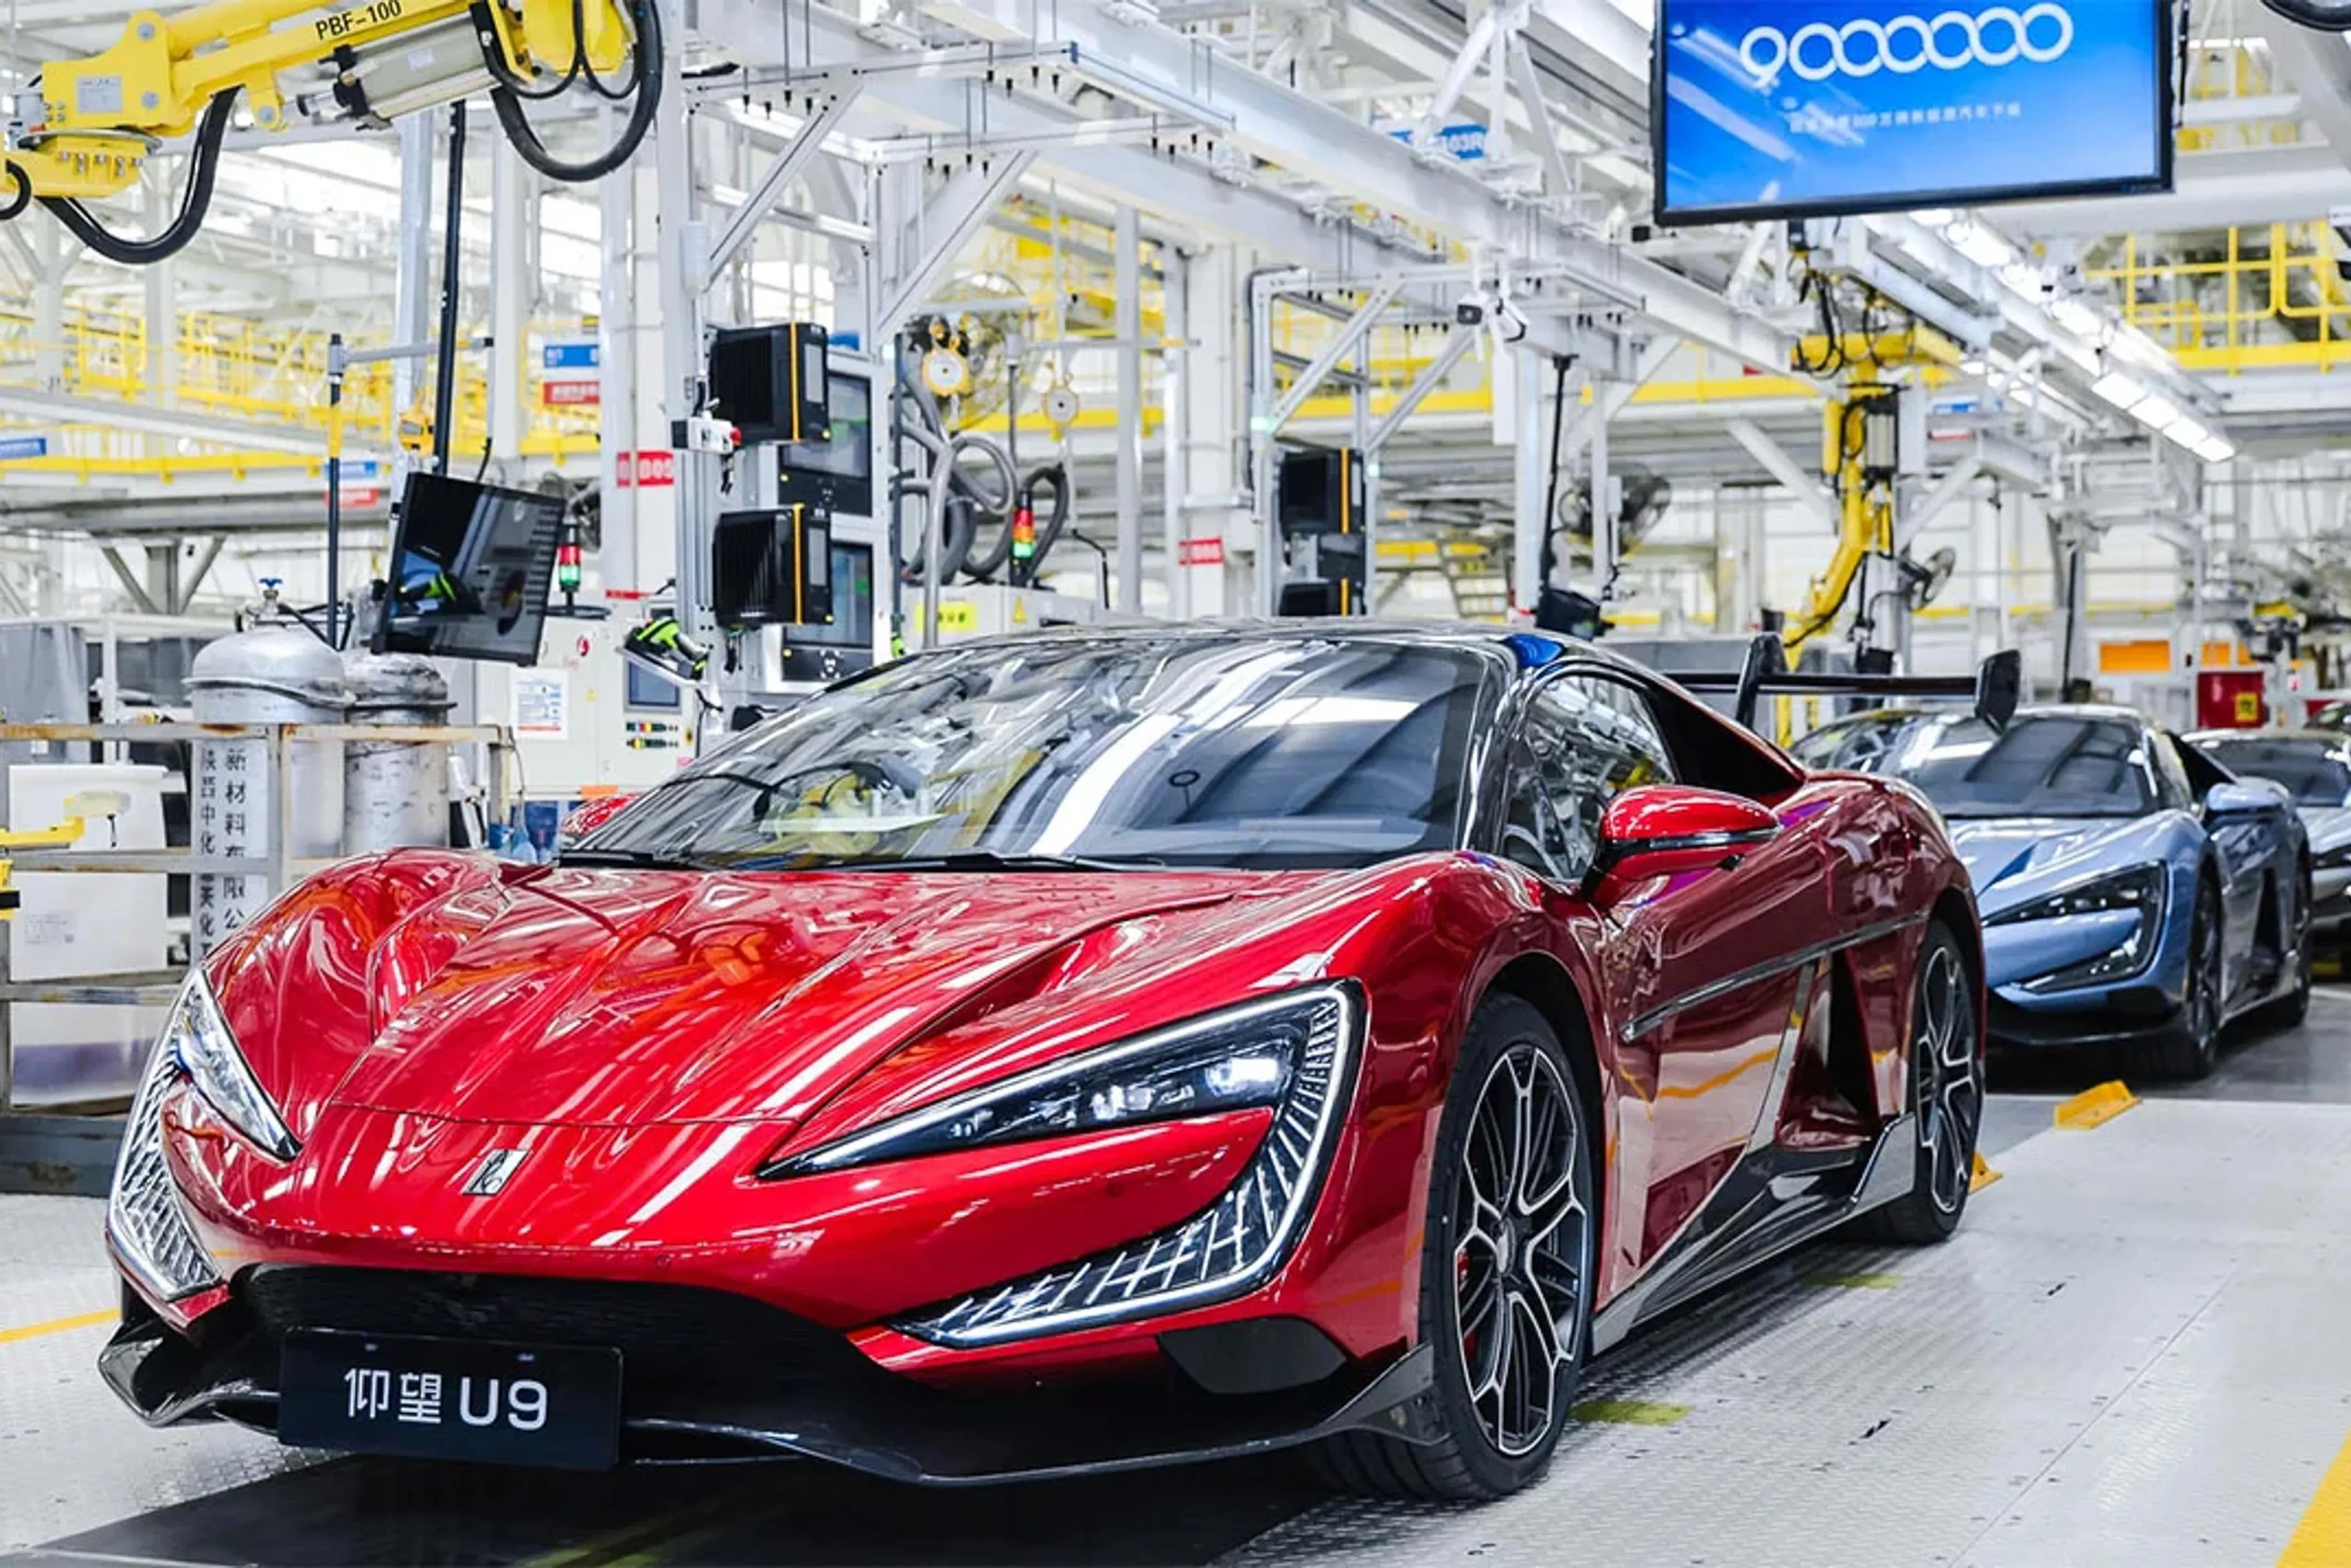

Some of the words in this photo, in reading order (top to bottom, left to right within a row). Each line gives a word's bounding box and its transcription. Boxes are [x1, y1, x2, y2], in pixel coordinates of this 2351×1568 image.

[315, 0, 402, 40] PBF-100
[344, 1368, 442, 1424] 仰望
[460, 1376, 548, 1430] U9
